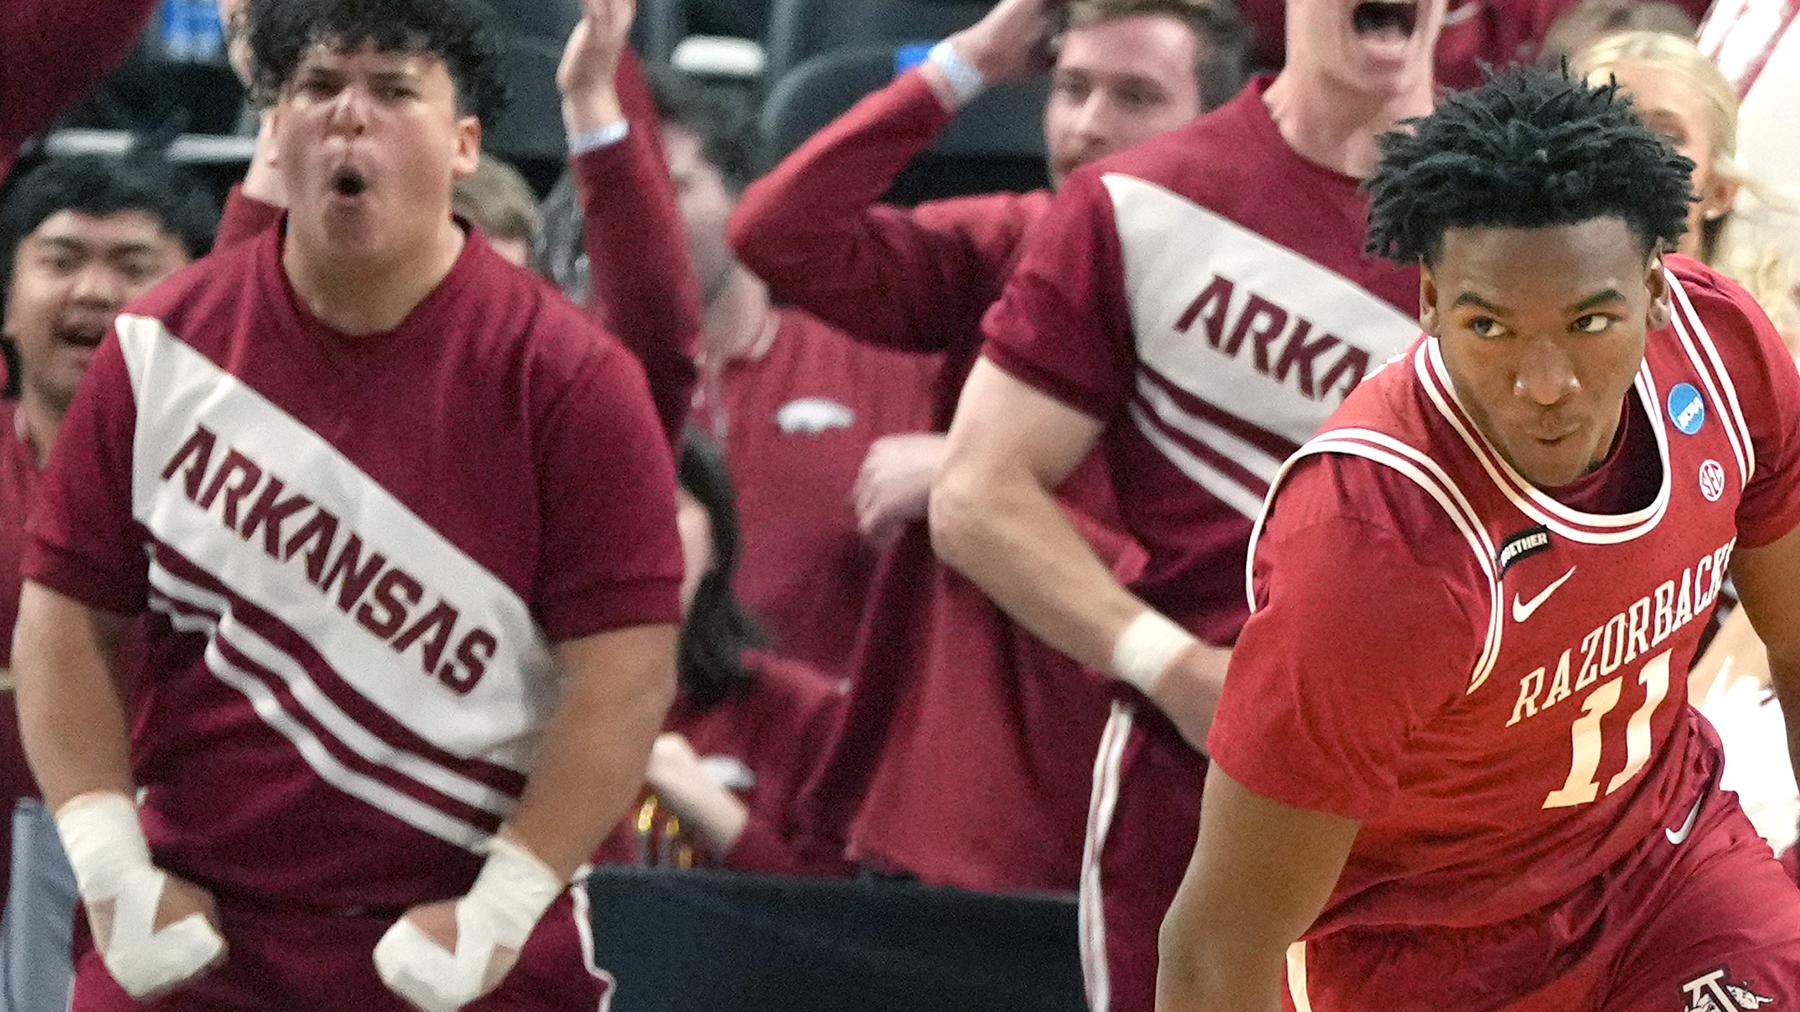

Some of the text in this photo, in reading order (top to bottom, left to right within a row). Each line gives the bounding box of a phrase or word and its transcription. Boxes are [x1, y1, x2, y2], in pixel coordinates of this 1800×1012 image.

[160, 424, 497, 696] ARKANSAS
[1701, 463, 1723, 498] SEC
[1541, 648, 1673, 809] 11
